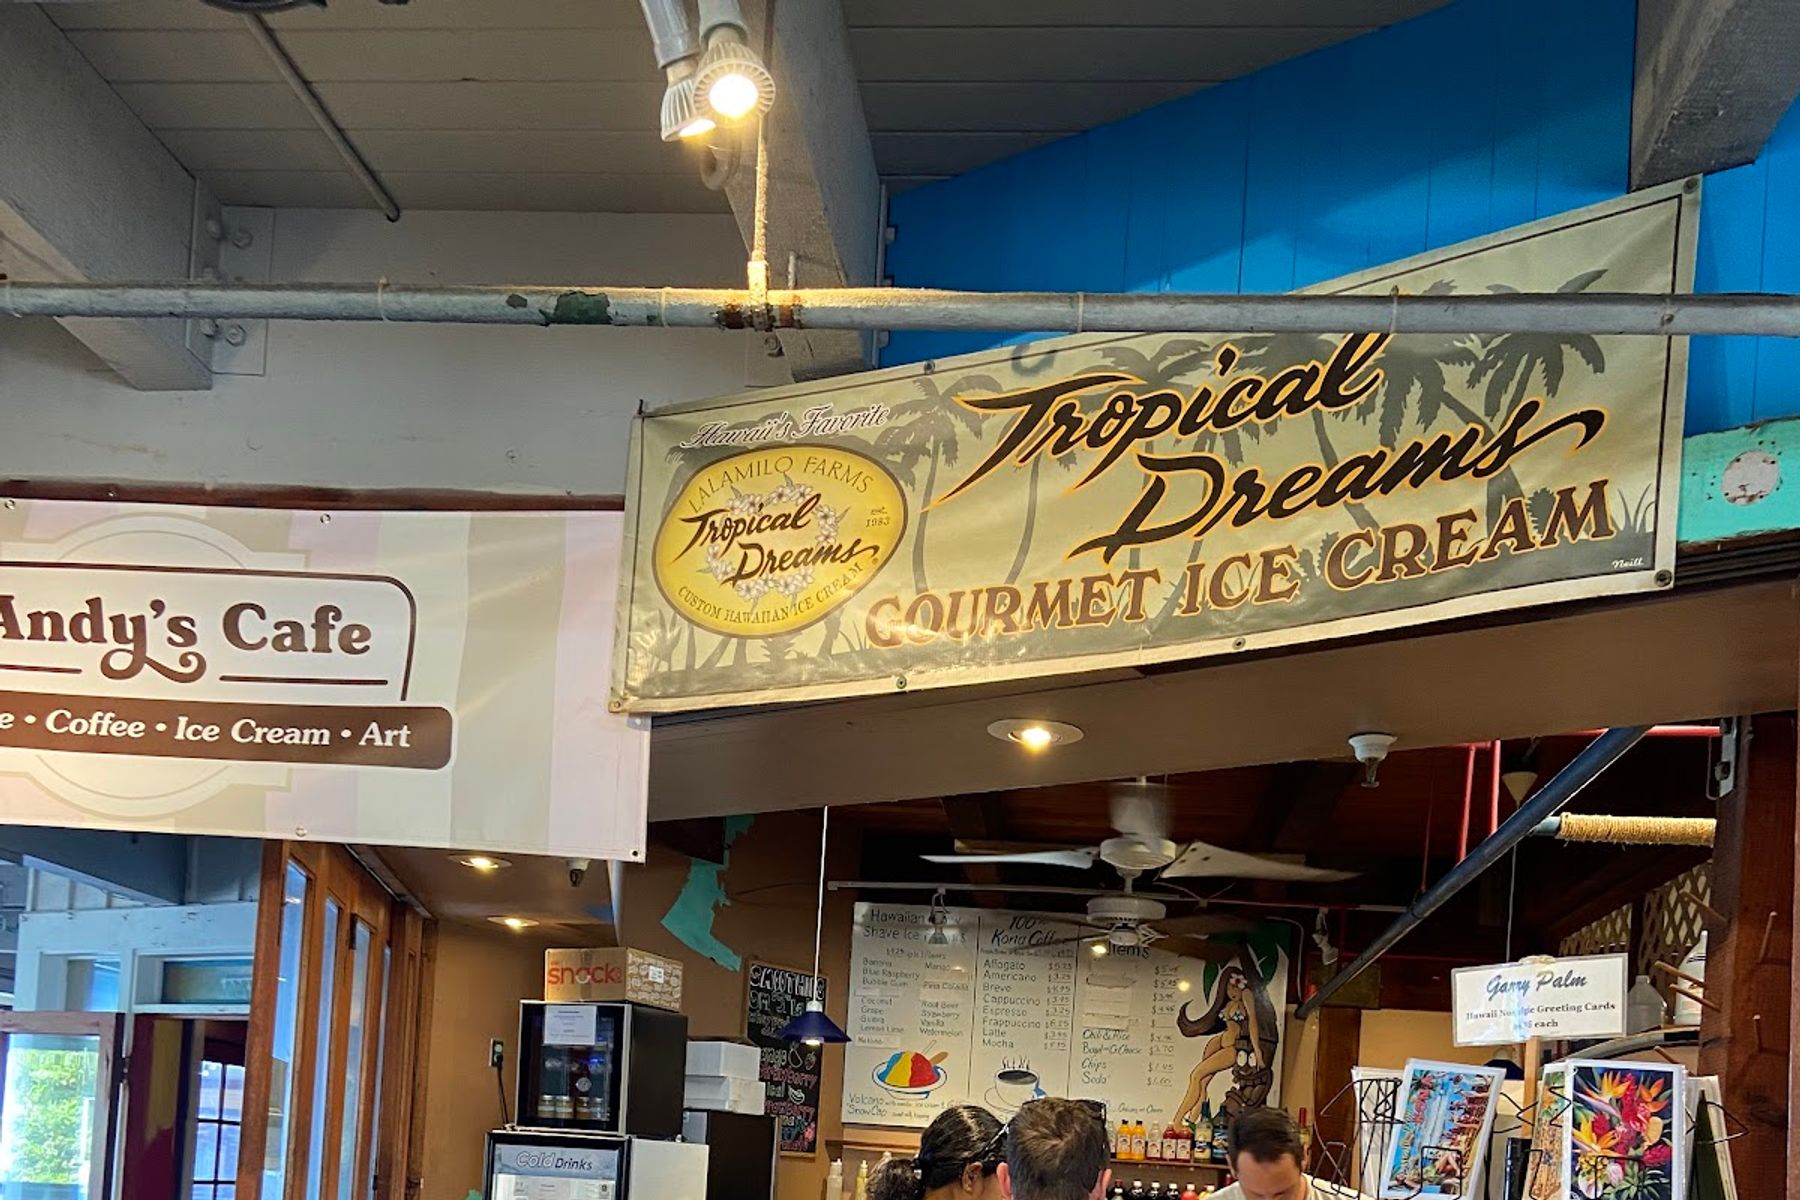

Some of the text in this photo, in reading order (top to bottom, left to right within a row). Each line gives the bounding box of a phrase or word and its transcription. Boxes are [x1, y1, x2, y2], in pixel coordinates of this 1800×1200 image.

[680, 403, 890, 450] Hawaii's Favorite
[921, 333, 1392, 511] Tropical
[688, 455, 874, 514] LALAMILO FARMS
[1064, 398, 1608, 565] Dreams
[672, 493, 822, 564] Tropical
[720, 538, 880, 589] Dreams
[866, 478, 1617, 648] GOURMET ICE CREAM
[678, 561, 865, 625] CUSTOM HAWAIIAN ICE CREAM
[0, 594, 373, 684] Andy's Cafe
[45, 709, 147, 740] Coffee
[173, 716, 221, 743] Ice
[230, 719, 331, 748] Cream
[358, 721, 412, 748] Art
[863, 925, 900, 939] Shave
[903, 927, 920, 941] Ice
[991, 928, 1027, 947] Kona
[983, 959, 1026, 971] Affogato
[983, 970, 1037, 982] Americano
[1536, 969, 1588, 992] Palm
[983, 993, 1041, 1006] Cappuccino
[1536, 1002, 1583, 1014] Greeting
[1584, 1001, 1616, 1011] Cards
[983, 1005, 1028, 1016] Espresso
[983, 1017, 1041, 1029] Frappuccino
[983, 1027, 1007, 1038] Latte
[1534, 1019, 1559, 1028] each
[982, 1039, 1014, 1049] Mocha
[516, 1150, 593, 1171] Cold Drinks
